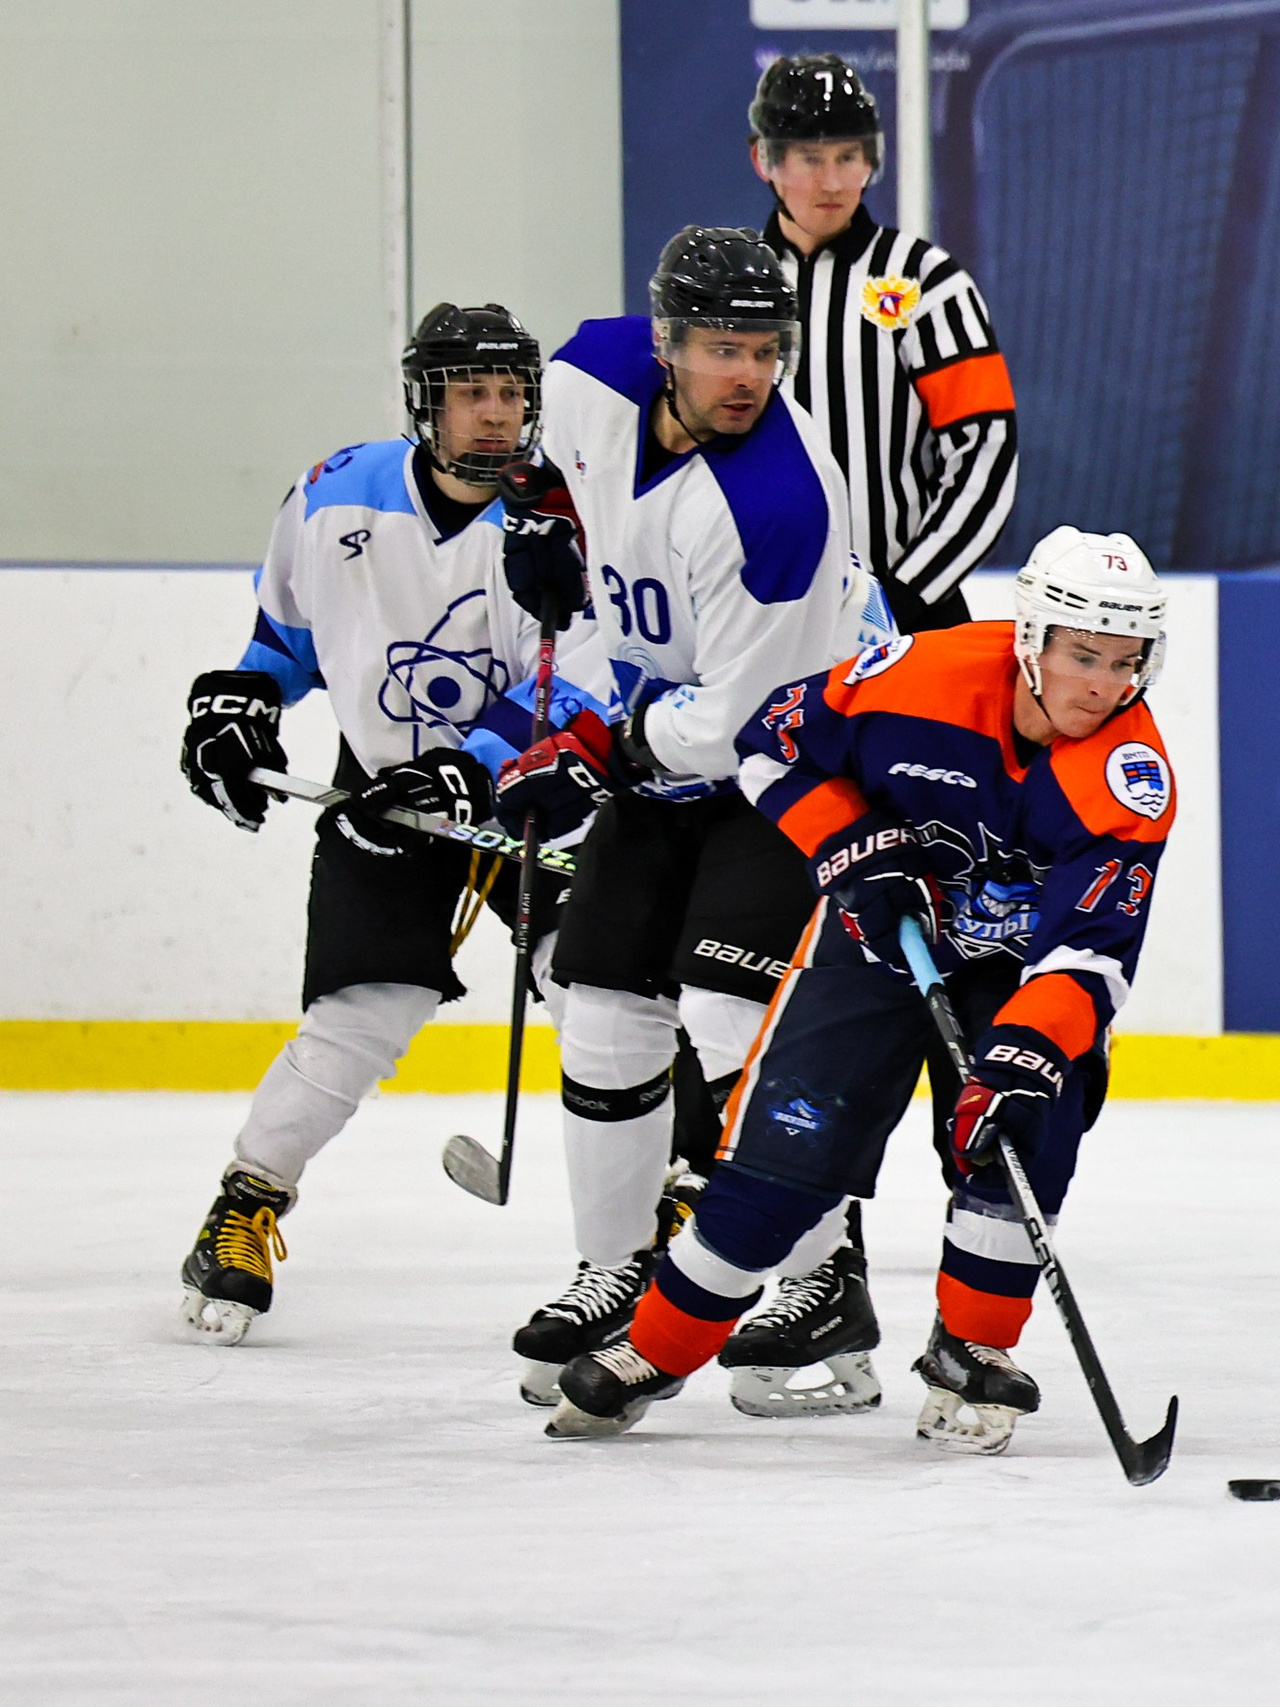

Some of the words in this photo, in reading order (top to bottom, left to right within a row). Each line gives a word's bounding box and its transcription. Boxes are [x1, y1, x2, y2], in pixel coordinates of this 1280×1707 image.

[502, 511, 556, 536] CM
[1102, 554, 1128, 572] 73
[601, 563, 672, 646] 30
[192, 694, 280, 724] CCM
[887, 762, 978, 788] FESCO
[693, 938, 792, 980] BAUE
[984, 1044, 1065, 1097] BAU
